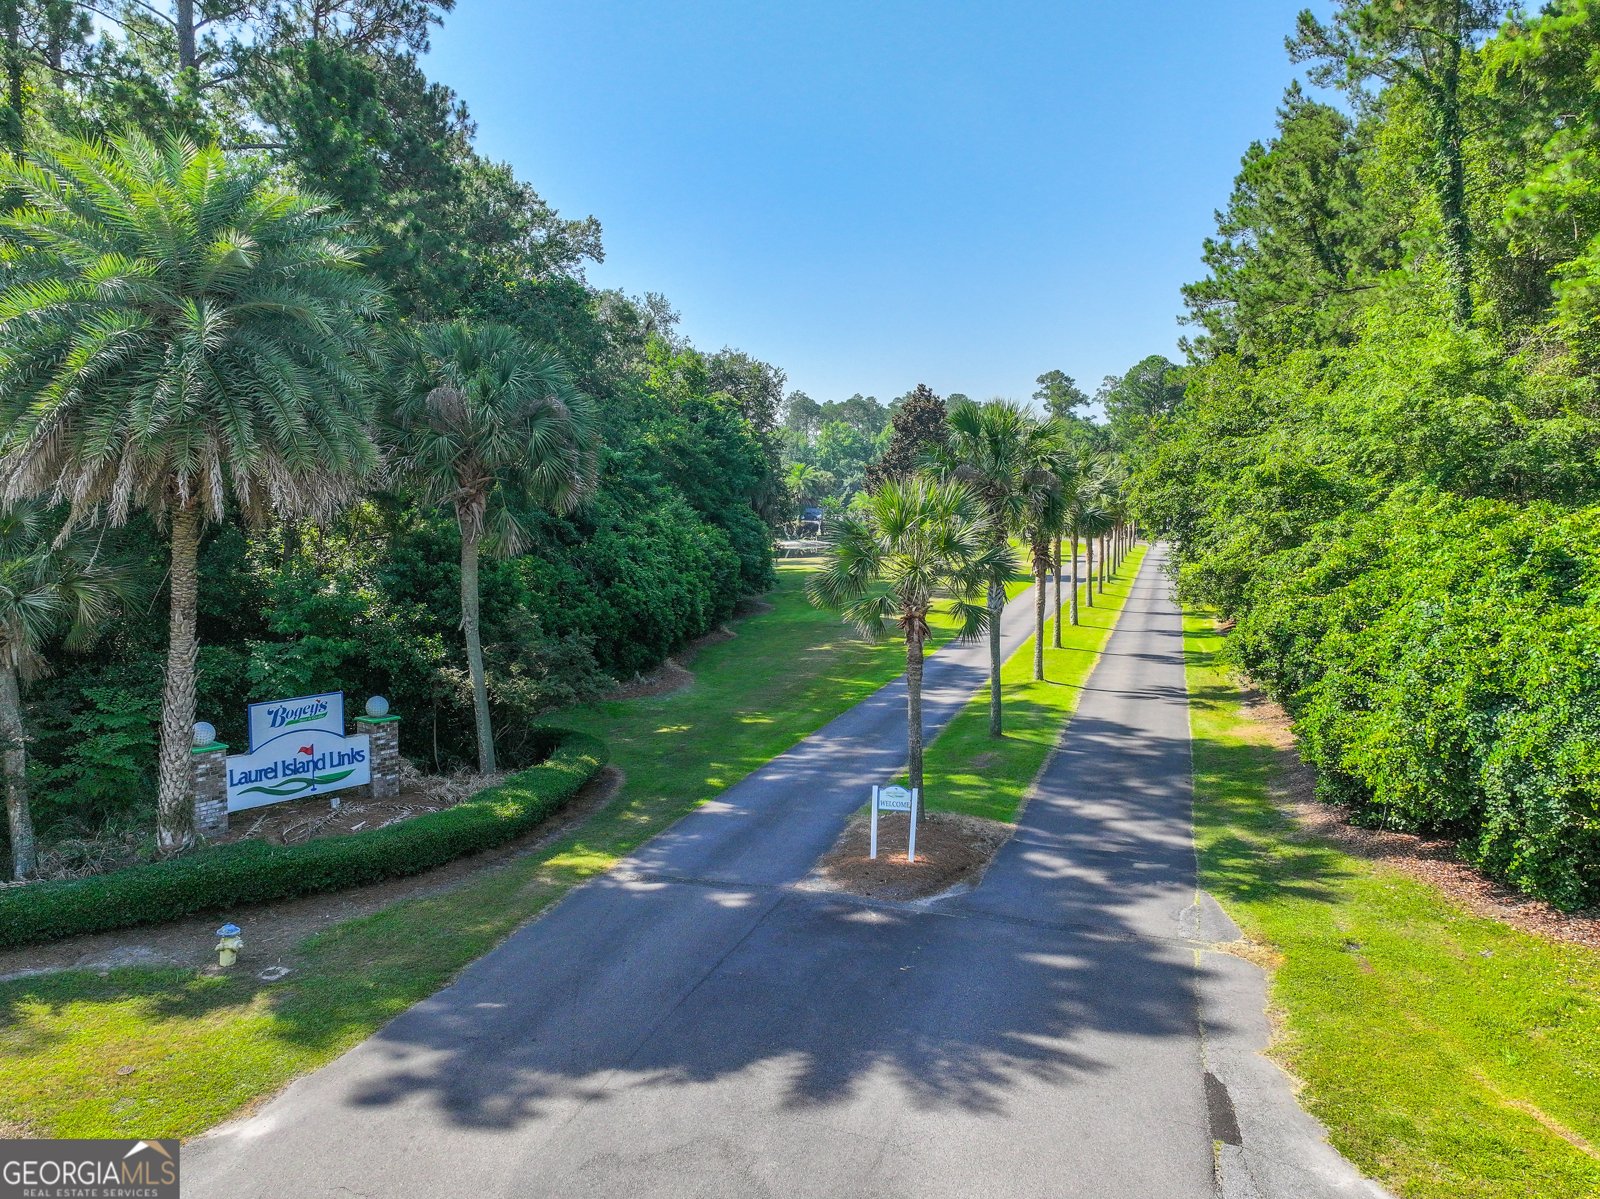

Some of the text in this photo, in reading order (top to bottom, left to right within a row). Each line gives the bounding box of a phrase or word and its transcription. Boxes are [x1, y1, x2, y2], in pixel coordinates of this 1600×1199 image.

[229, 747, 366, 787] Laurel Island Links
[880, 800, 911, 808] WELCOME
